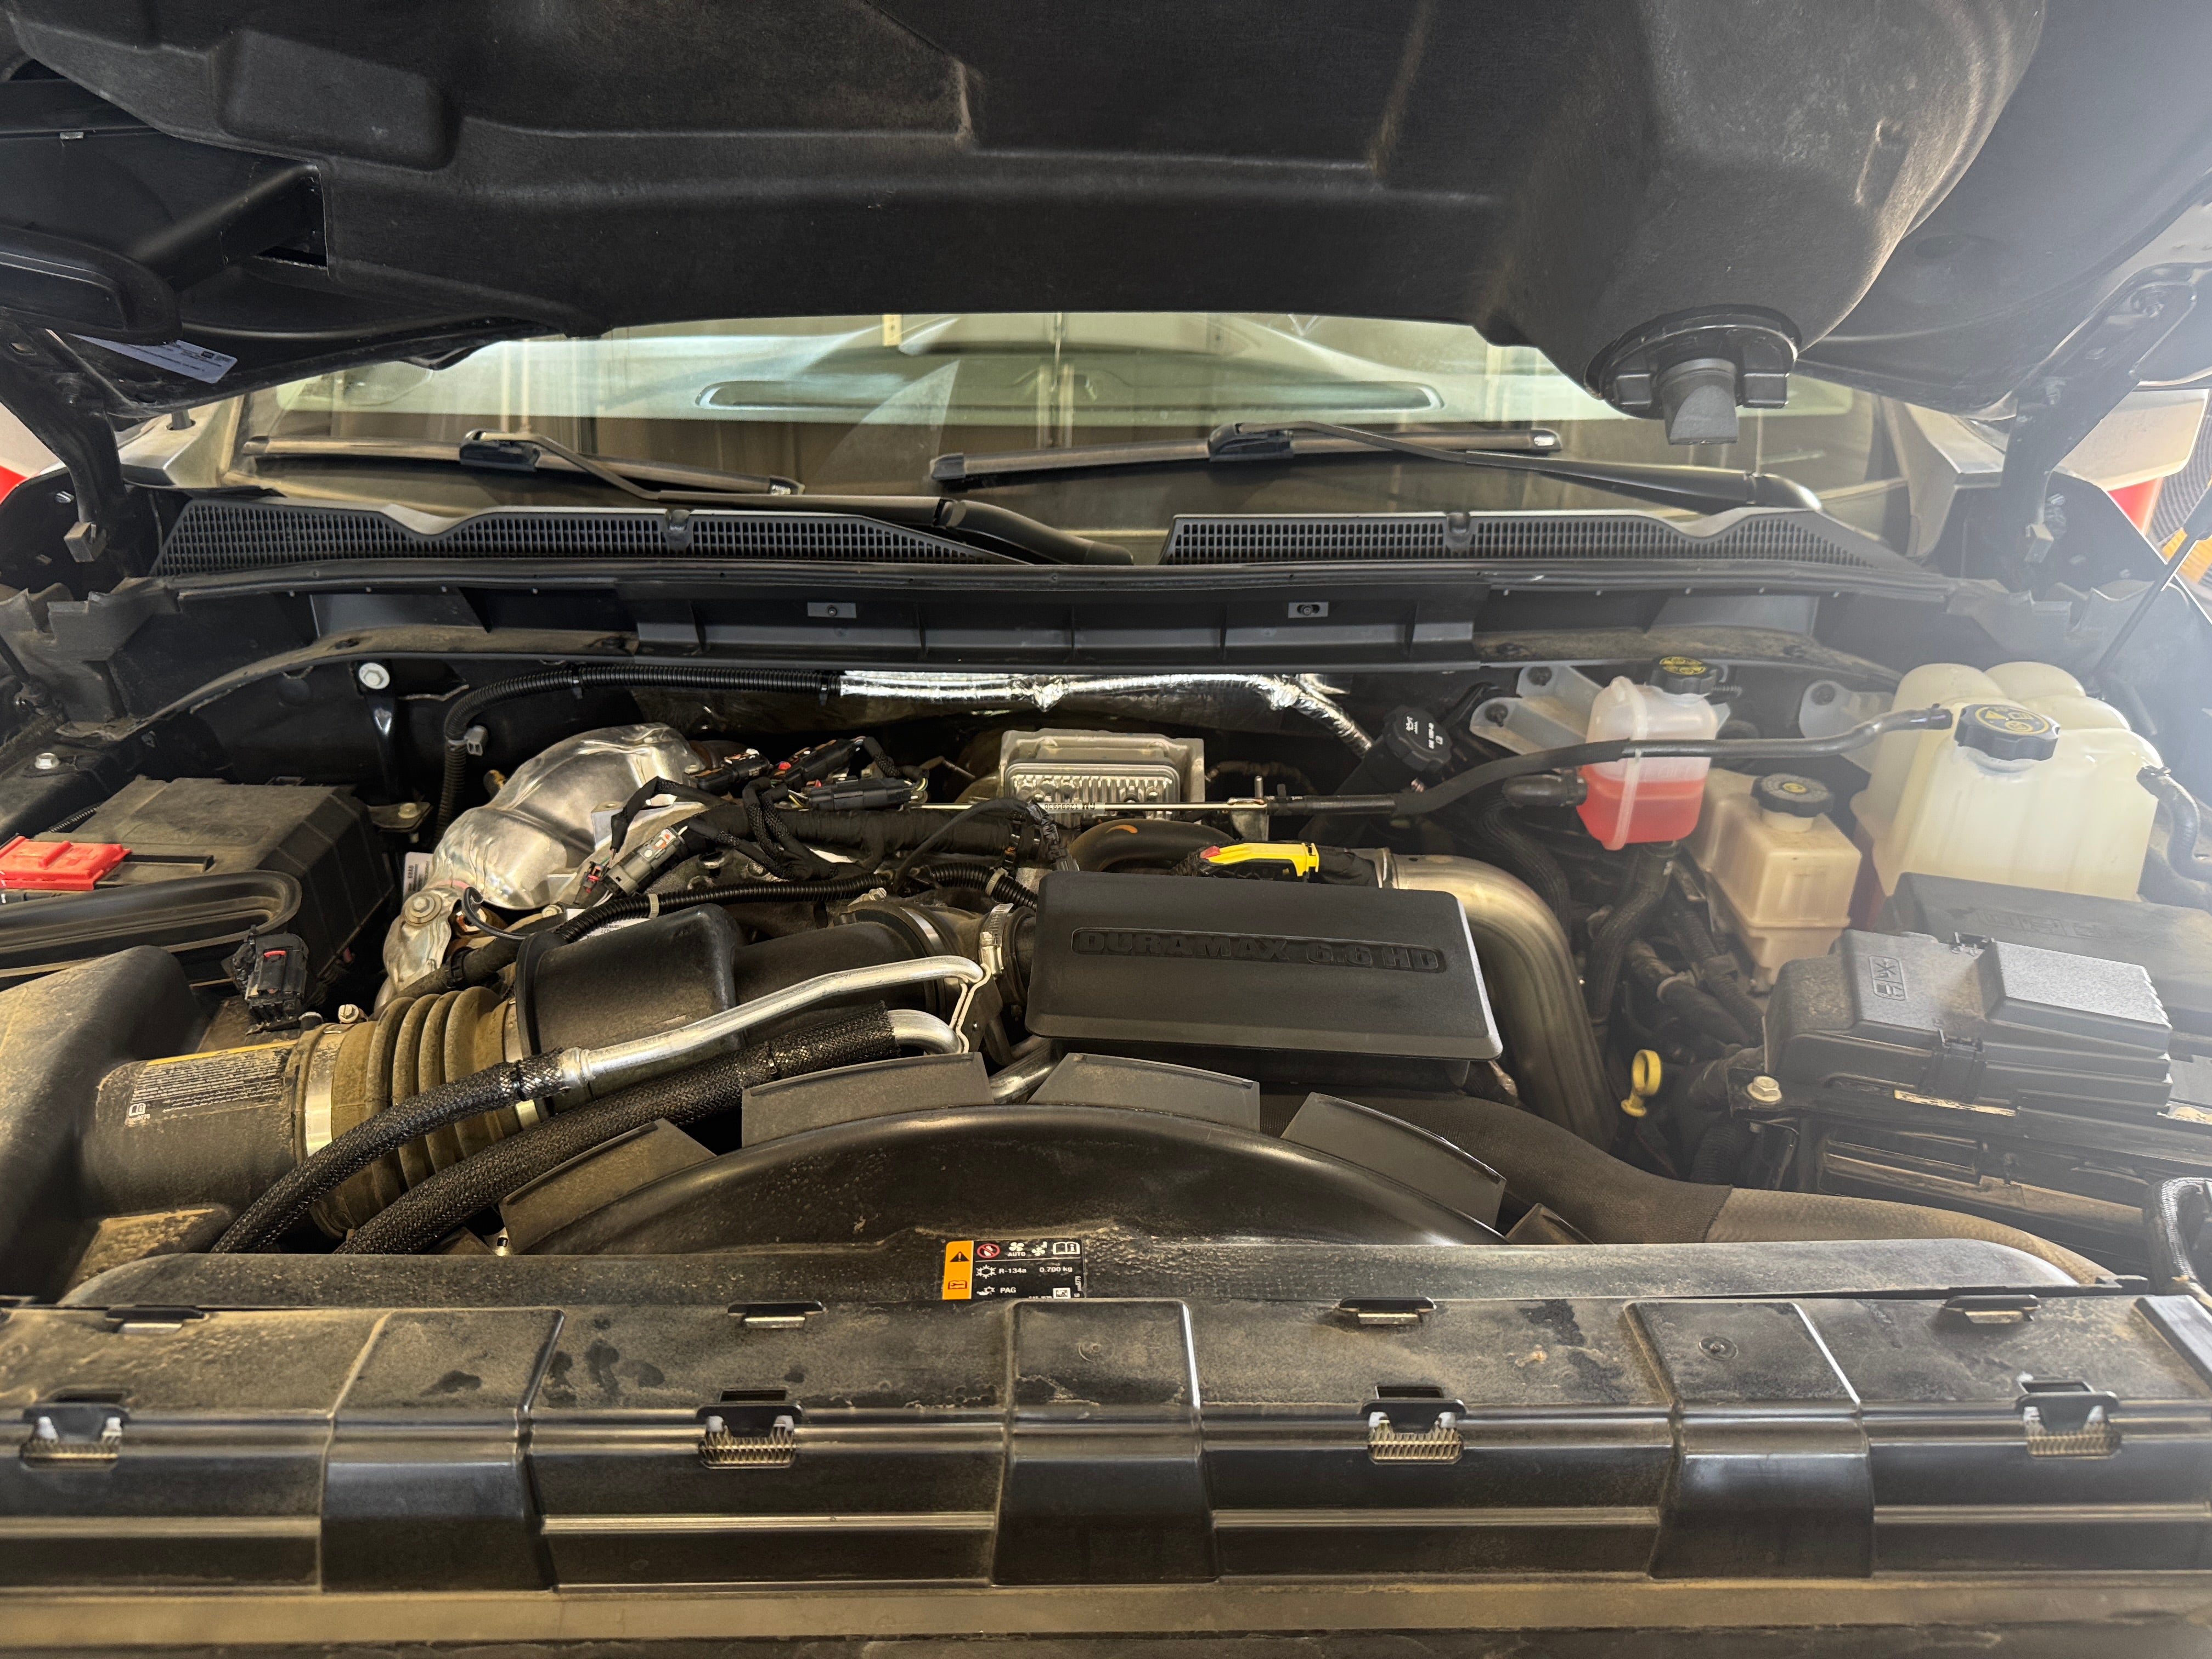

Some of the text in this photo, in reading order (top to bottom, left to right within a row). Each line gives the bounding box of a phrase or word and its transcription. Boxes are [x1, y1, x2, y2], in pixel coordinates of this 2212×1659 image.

[1079, 933, 1438, 970] DURAMAX 6.6 HD
